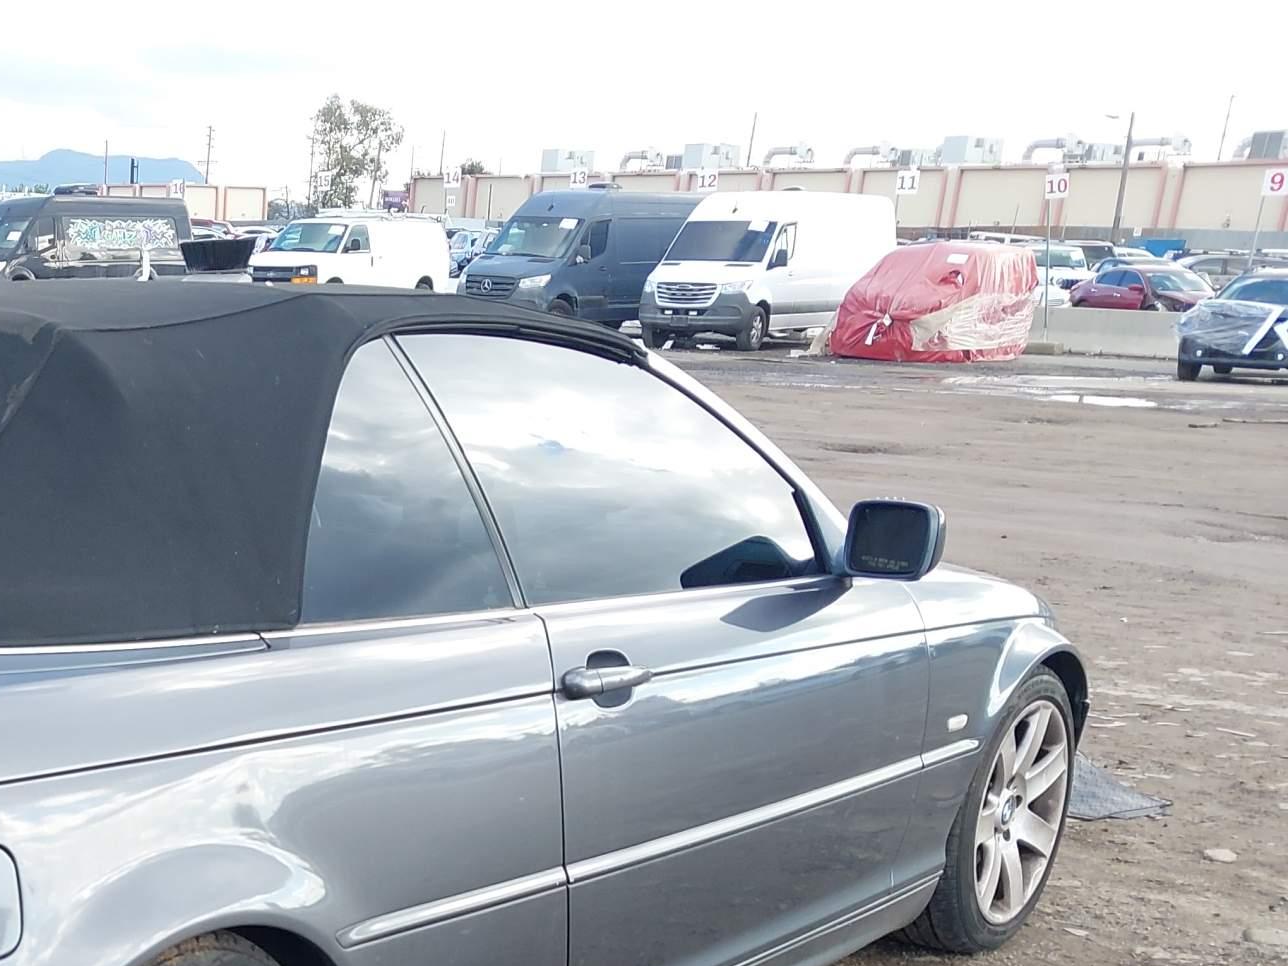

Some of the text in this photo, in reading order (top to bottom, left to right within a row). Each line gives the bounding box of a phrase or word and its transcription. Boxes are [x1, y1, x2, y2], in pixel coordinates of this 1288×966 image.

[318, 174, 330, 187] 15
[445, 171, 460, 184] 14
[571, 171, 586, 184] 13
[698, 174, 717, 188] 12
[897, 175, 917, 190] 11
[1269, 172, 1285, 192] 9
[1046, 178, 1068, 194] 10
